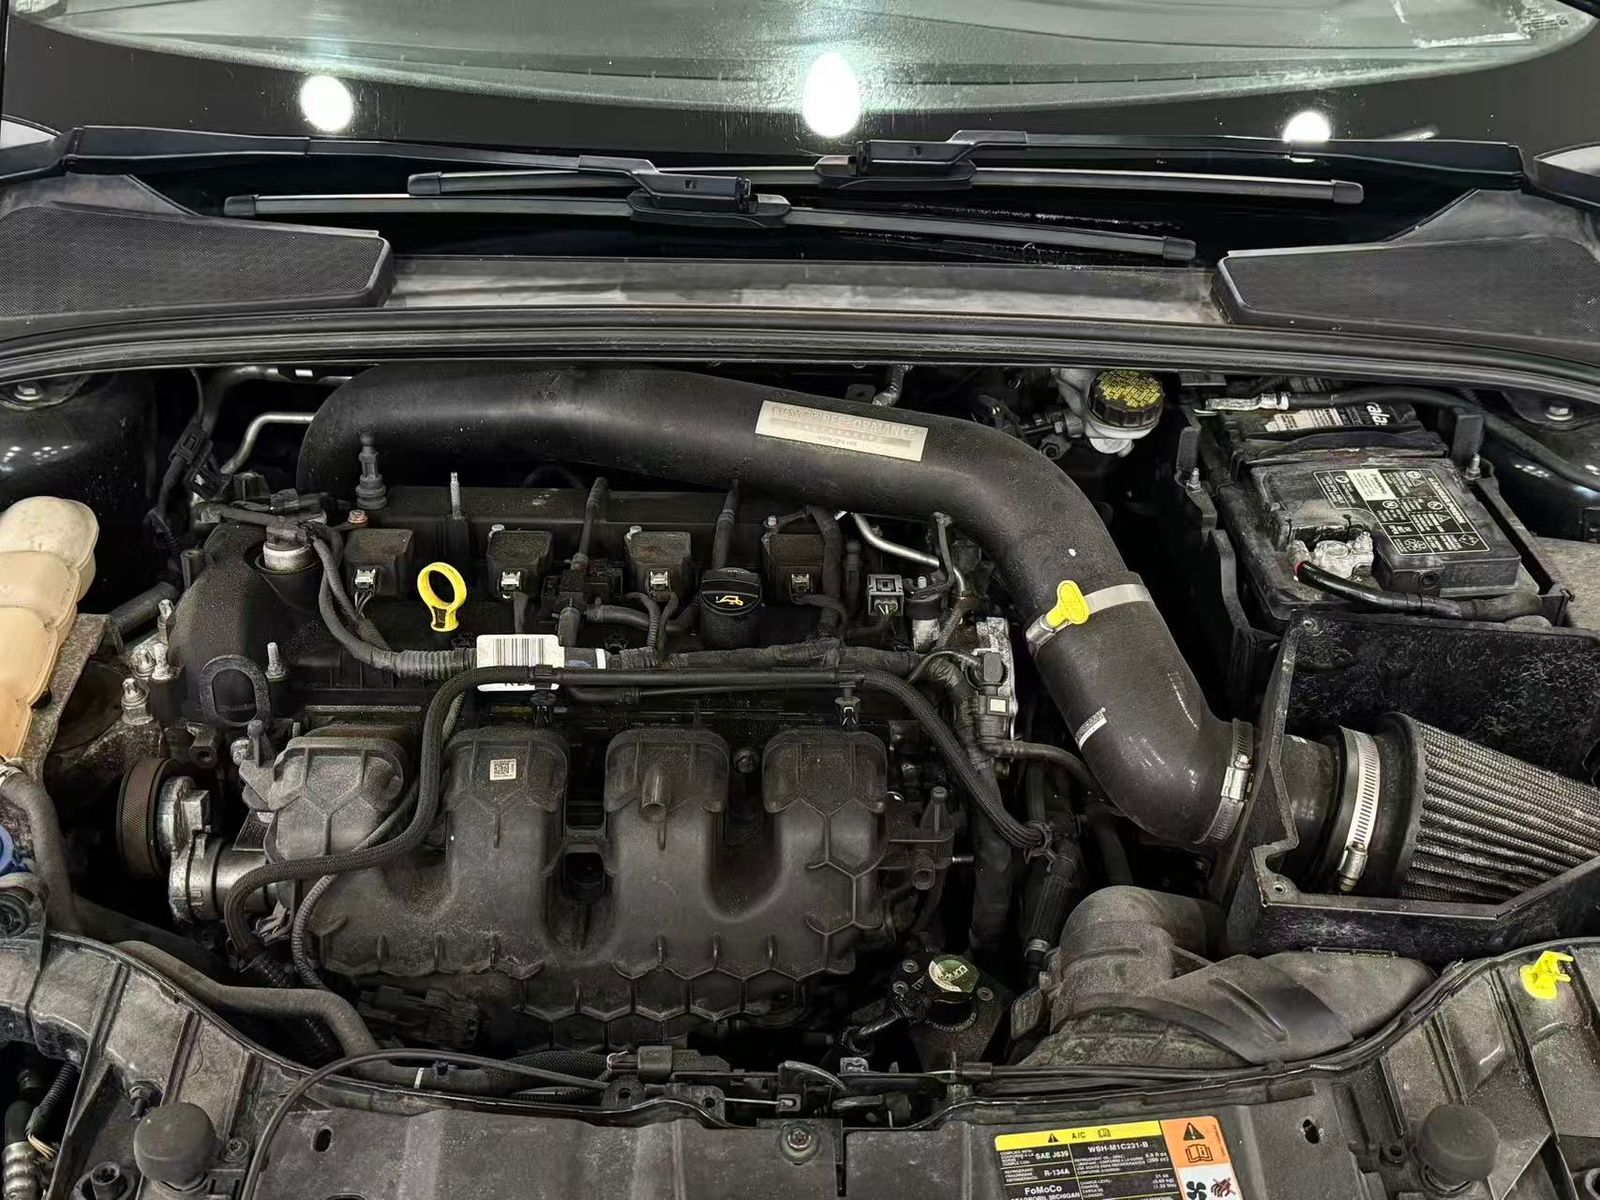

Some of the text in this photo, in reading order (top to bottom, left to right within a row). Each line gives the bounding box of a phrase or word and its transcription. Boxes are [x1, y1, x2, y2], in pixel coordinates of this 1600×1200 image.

[1072, 1131, 1086, 1139] A/C
[1035, 1152, 1051, 1160] SAE
[1044, 1168, 1070, 1176] R-134A
[1024, 1185, 1062, 1195] FoMoCo
[1049, 1192, 1080, 1200] MICHIGAN
